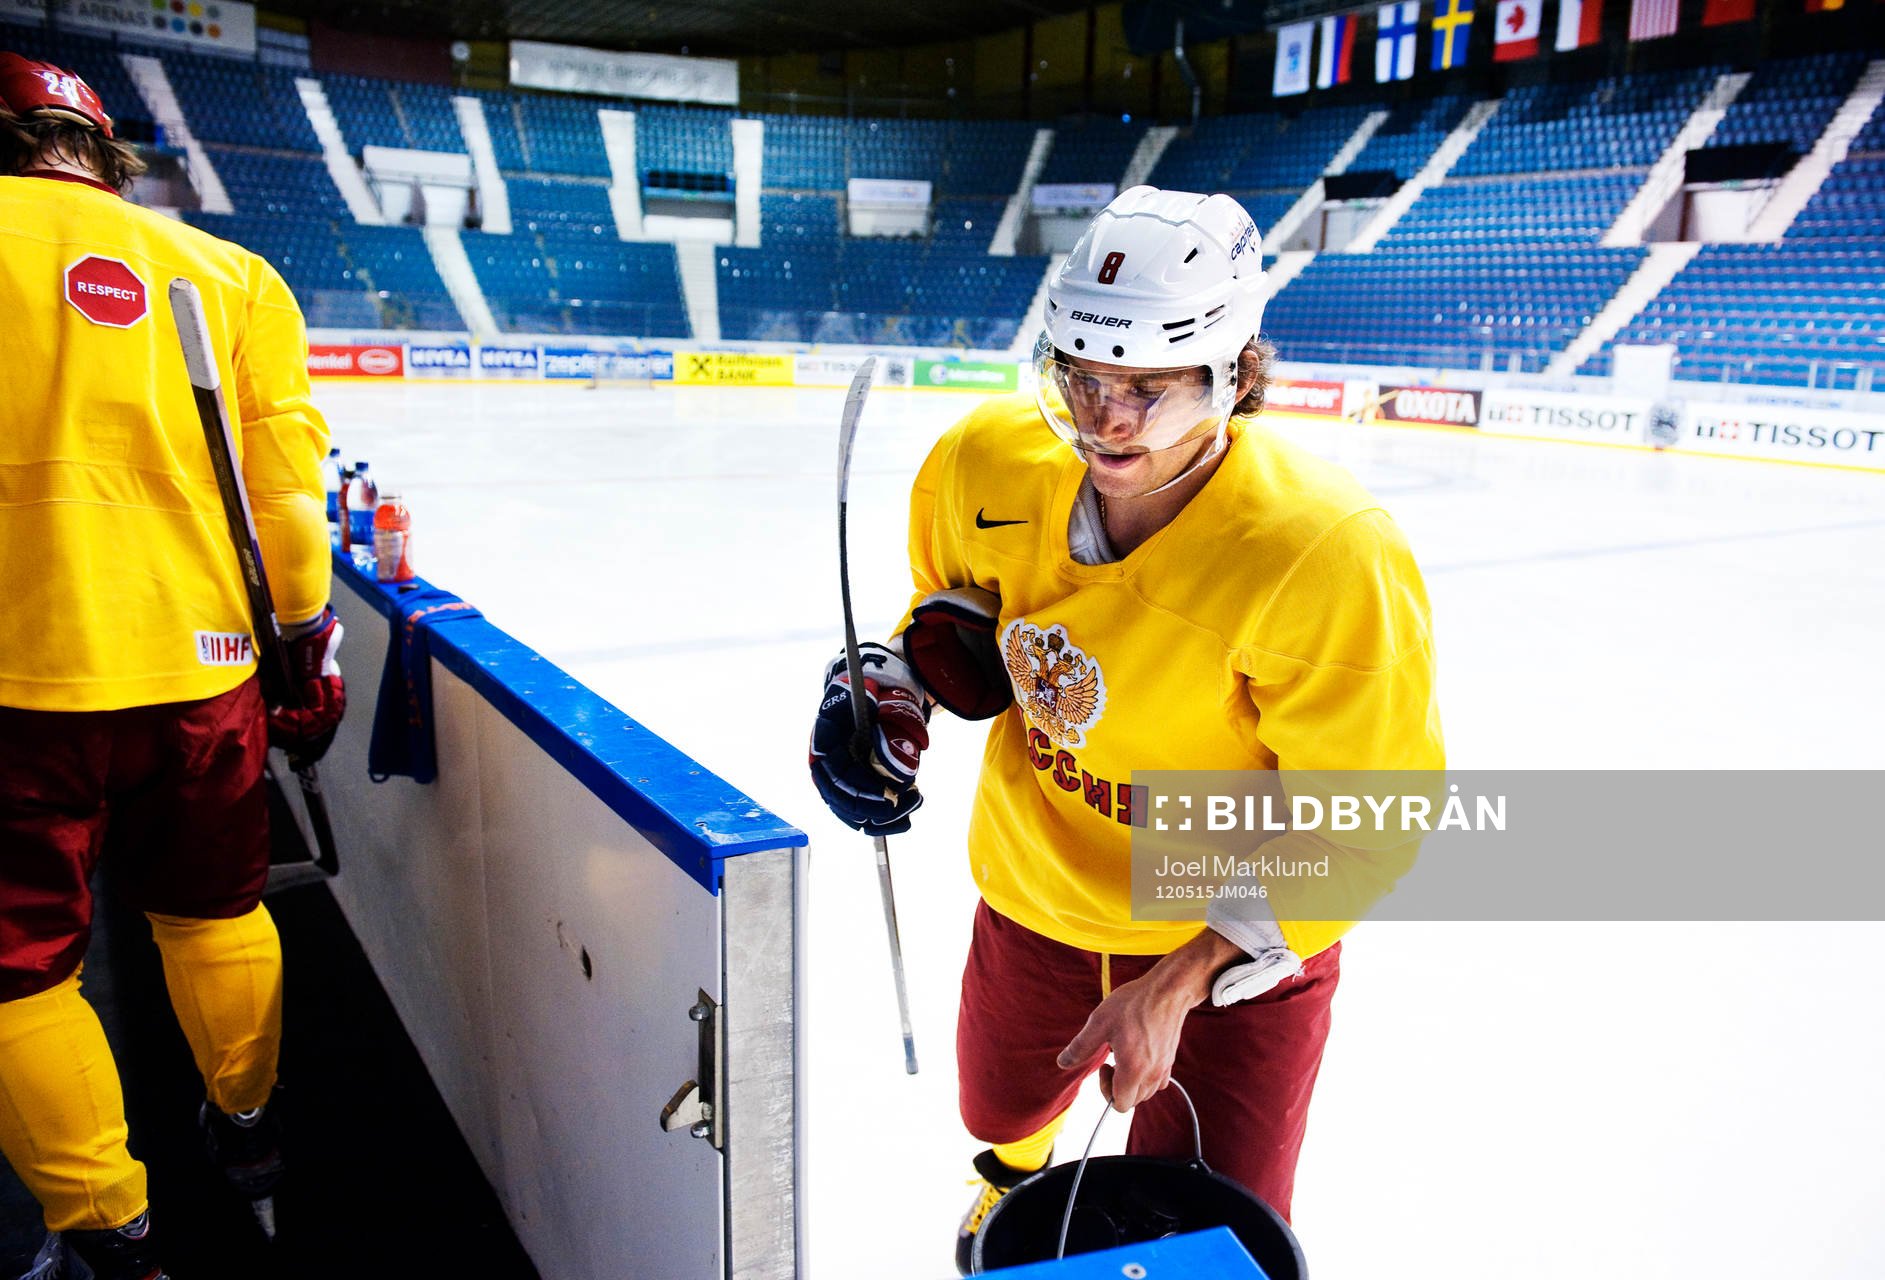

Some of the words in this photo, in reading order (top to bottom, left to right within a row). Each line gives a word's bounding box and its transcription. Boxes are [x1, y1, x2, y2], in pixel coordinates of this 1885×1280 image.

[1097, 251, 1126, 285] 8
[76, 281, 138, 302] RESPECT
[1070, 310, 1133, 329] BAUER
[411, 349, 469, 367] NIVEA
[481, 350, 536, 368] NIVEA
[1530, 405, 1639, 431] TISSOT
[1748, 421, 1885, 452] TISSOT
[210, 636, 250, 662] IIHF
[1027, 727, 1149, 829] ССИЯ
